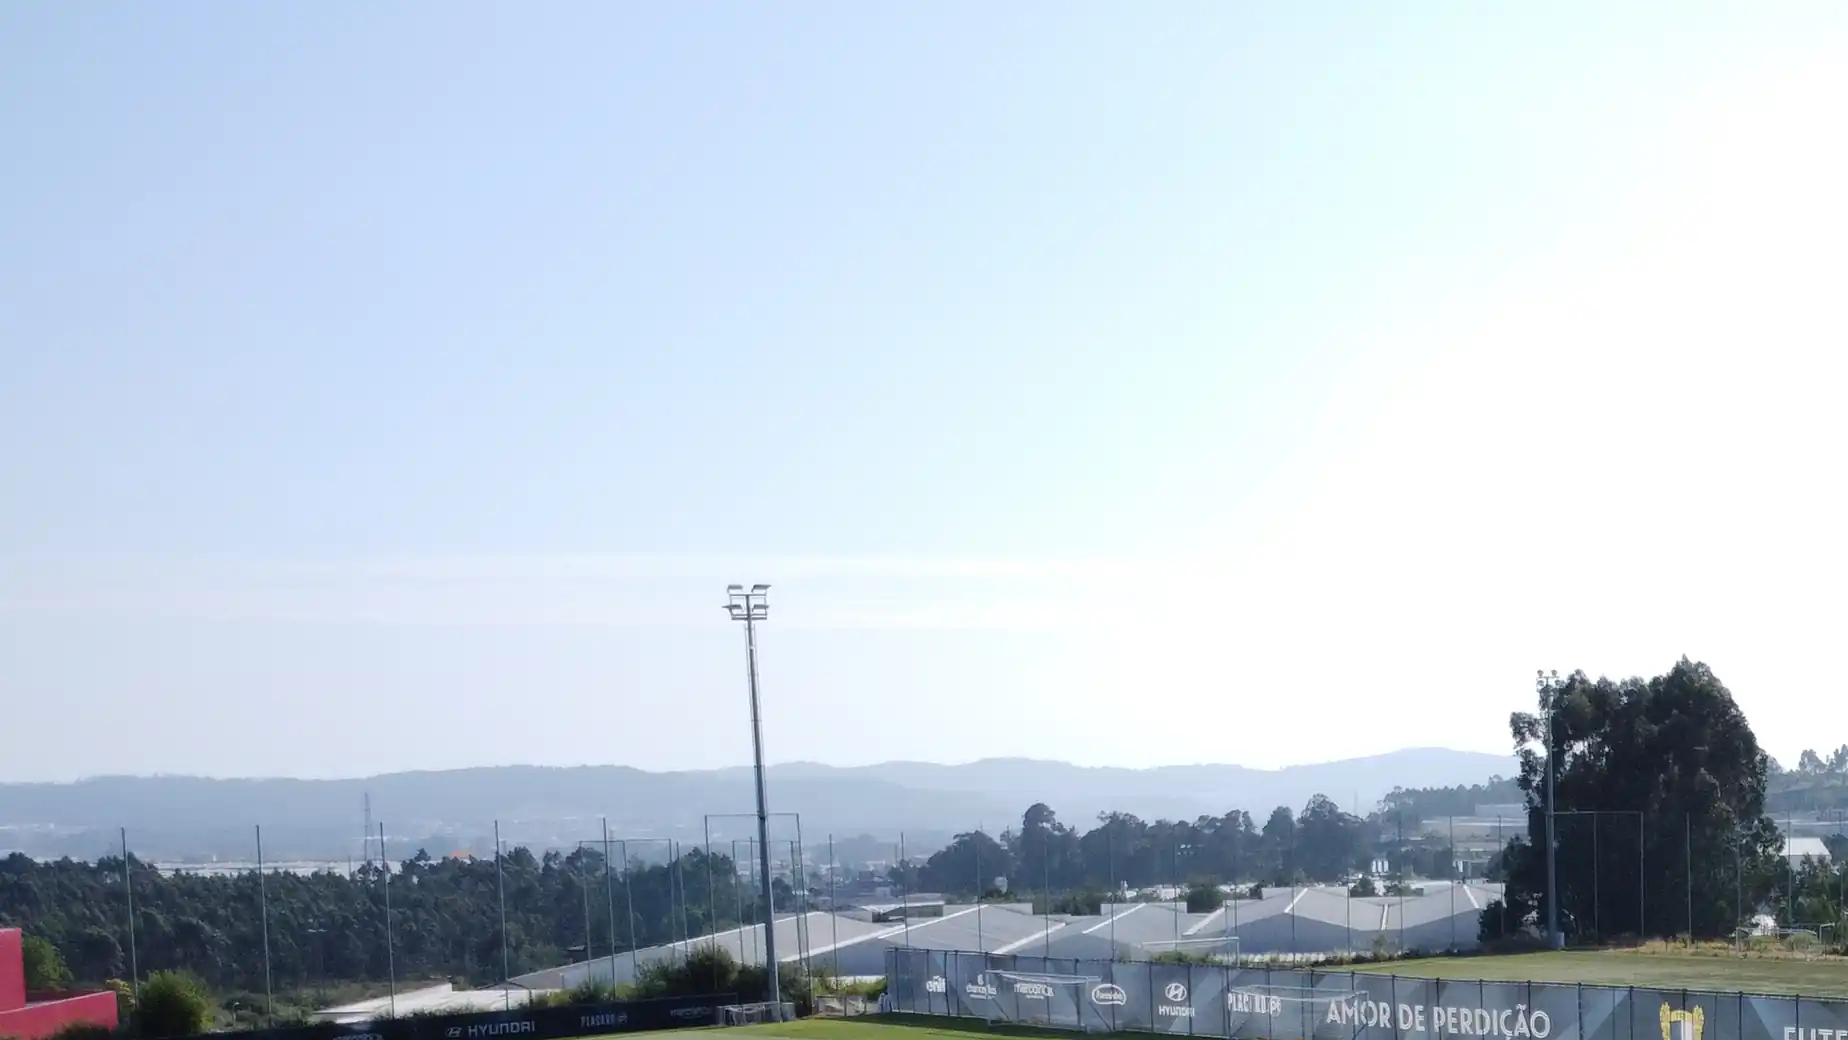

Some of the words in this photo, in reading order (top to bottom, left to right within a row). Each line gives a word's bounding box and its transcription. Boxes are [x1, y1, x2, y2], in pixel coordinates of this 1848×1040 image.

[1326, 999, 1392, 1028] AMOR
[1399, 1003, 1426, 1032] DE
[468, 1020, 536, 1038] HYUNDAI
